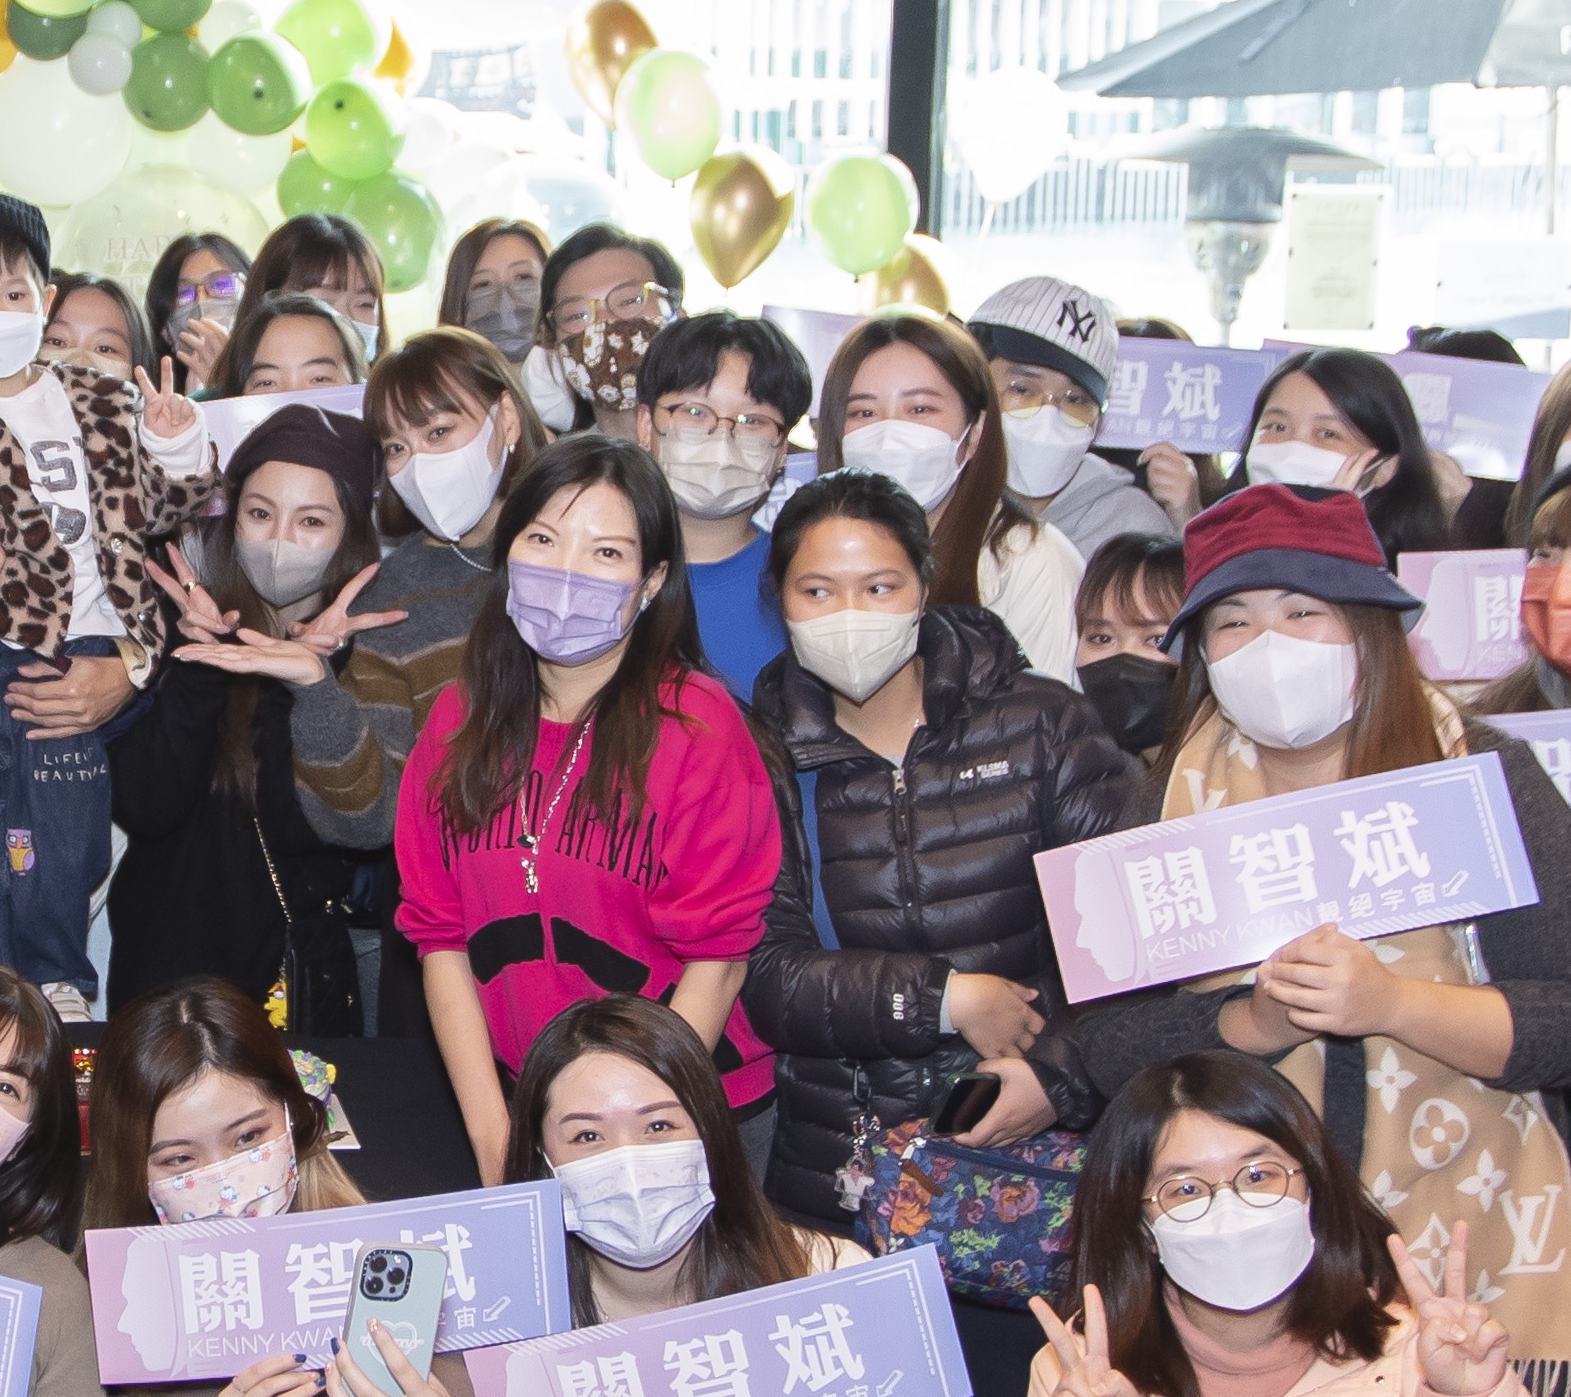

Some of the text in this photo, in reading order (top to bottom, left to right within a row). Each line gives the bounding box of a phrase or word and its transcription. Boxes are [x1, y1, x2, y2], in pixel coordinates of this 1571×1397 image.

[1057, 298, 1097, 344] NY
[43, 752, 81, 766] LIFE
[1123, 801, 1433, 942] 關智斌
[1145, 928, 1231, 964] KENNY
[1235, 907, 1315, 946] KWAN
[187, 1332, 275, 1360] KENNY
[280, 1323, 346, 1356] KWA
